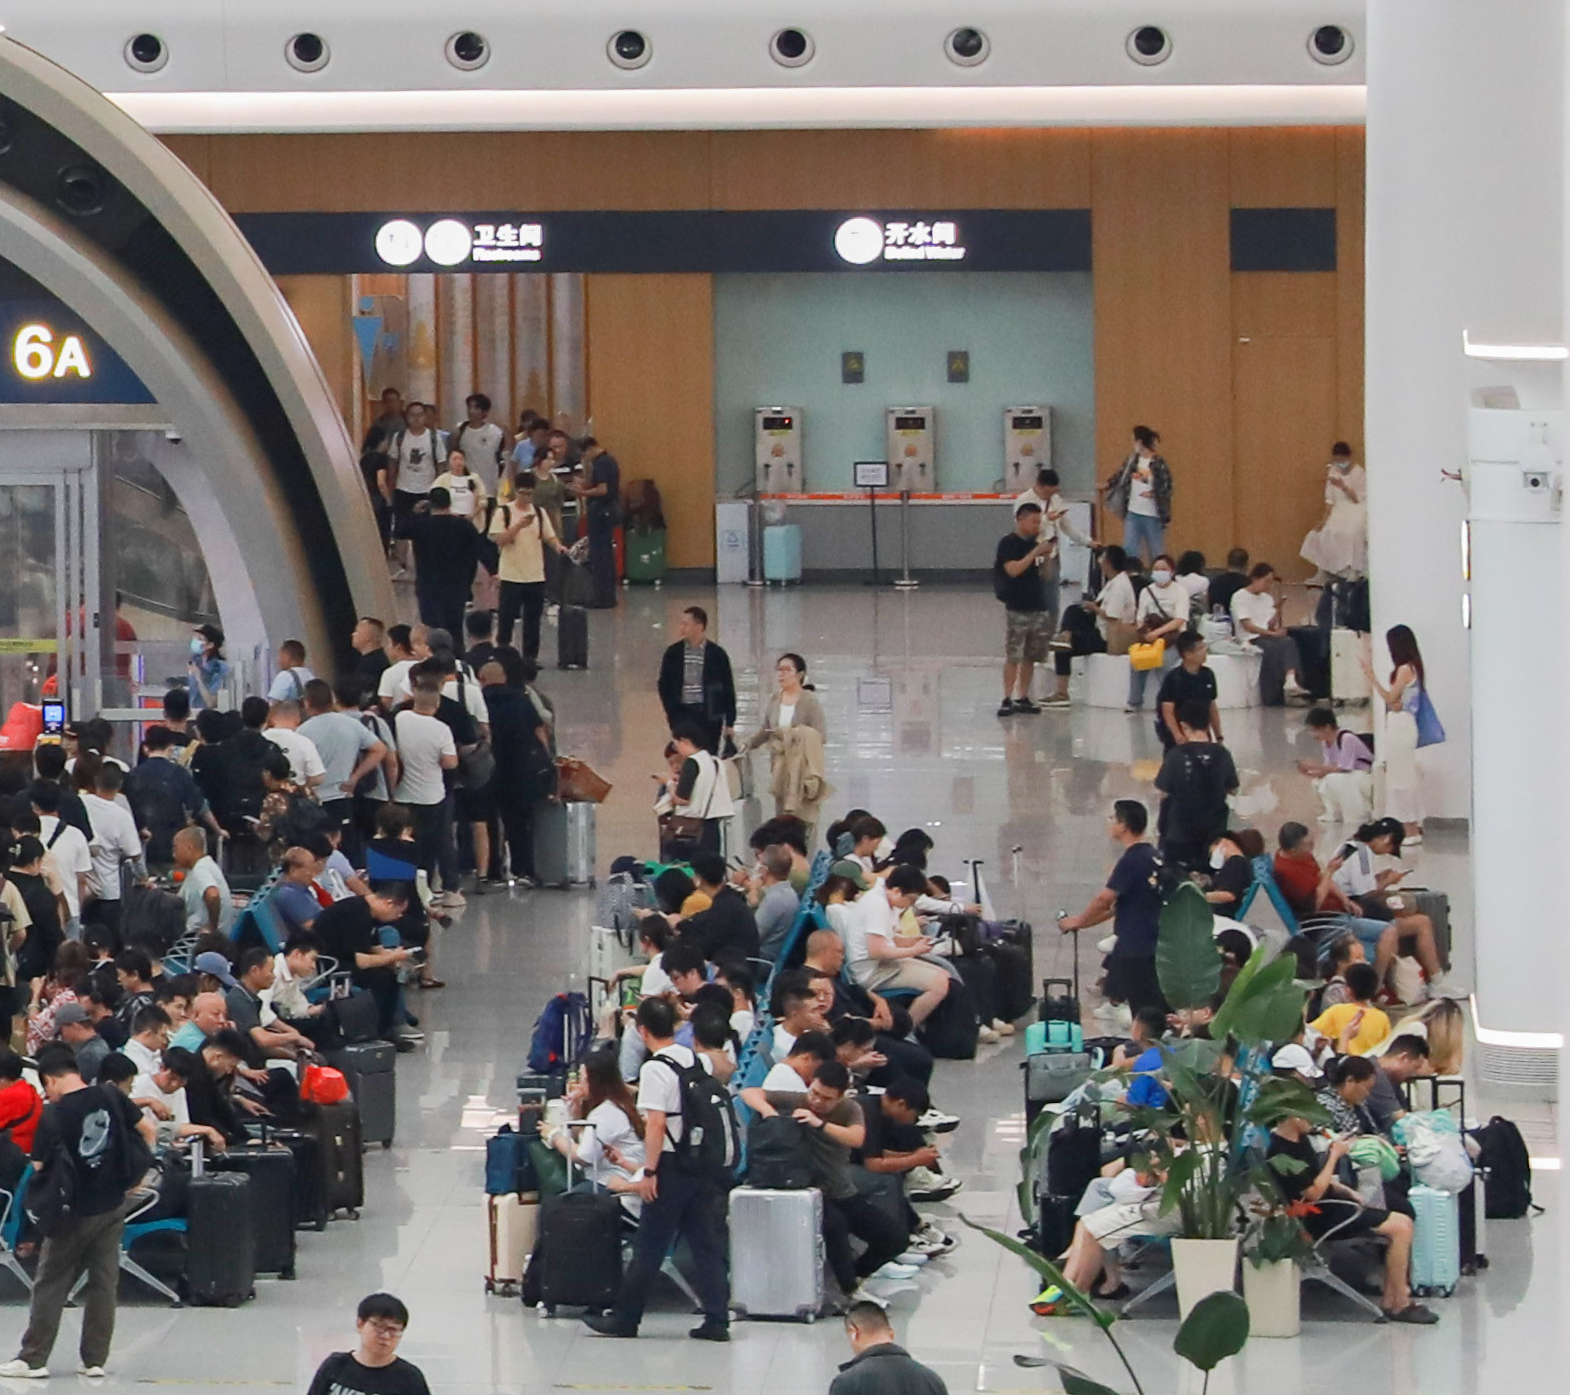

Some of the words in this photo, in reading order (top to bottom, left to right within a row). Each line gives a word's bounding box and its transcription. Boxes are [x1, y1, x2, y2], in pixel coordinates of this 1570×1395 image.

[473, 224, 542, 246] 卫生间
[885, 222, 956, 245] 开水间
[16, 326, 89, 378] 6A
